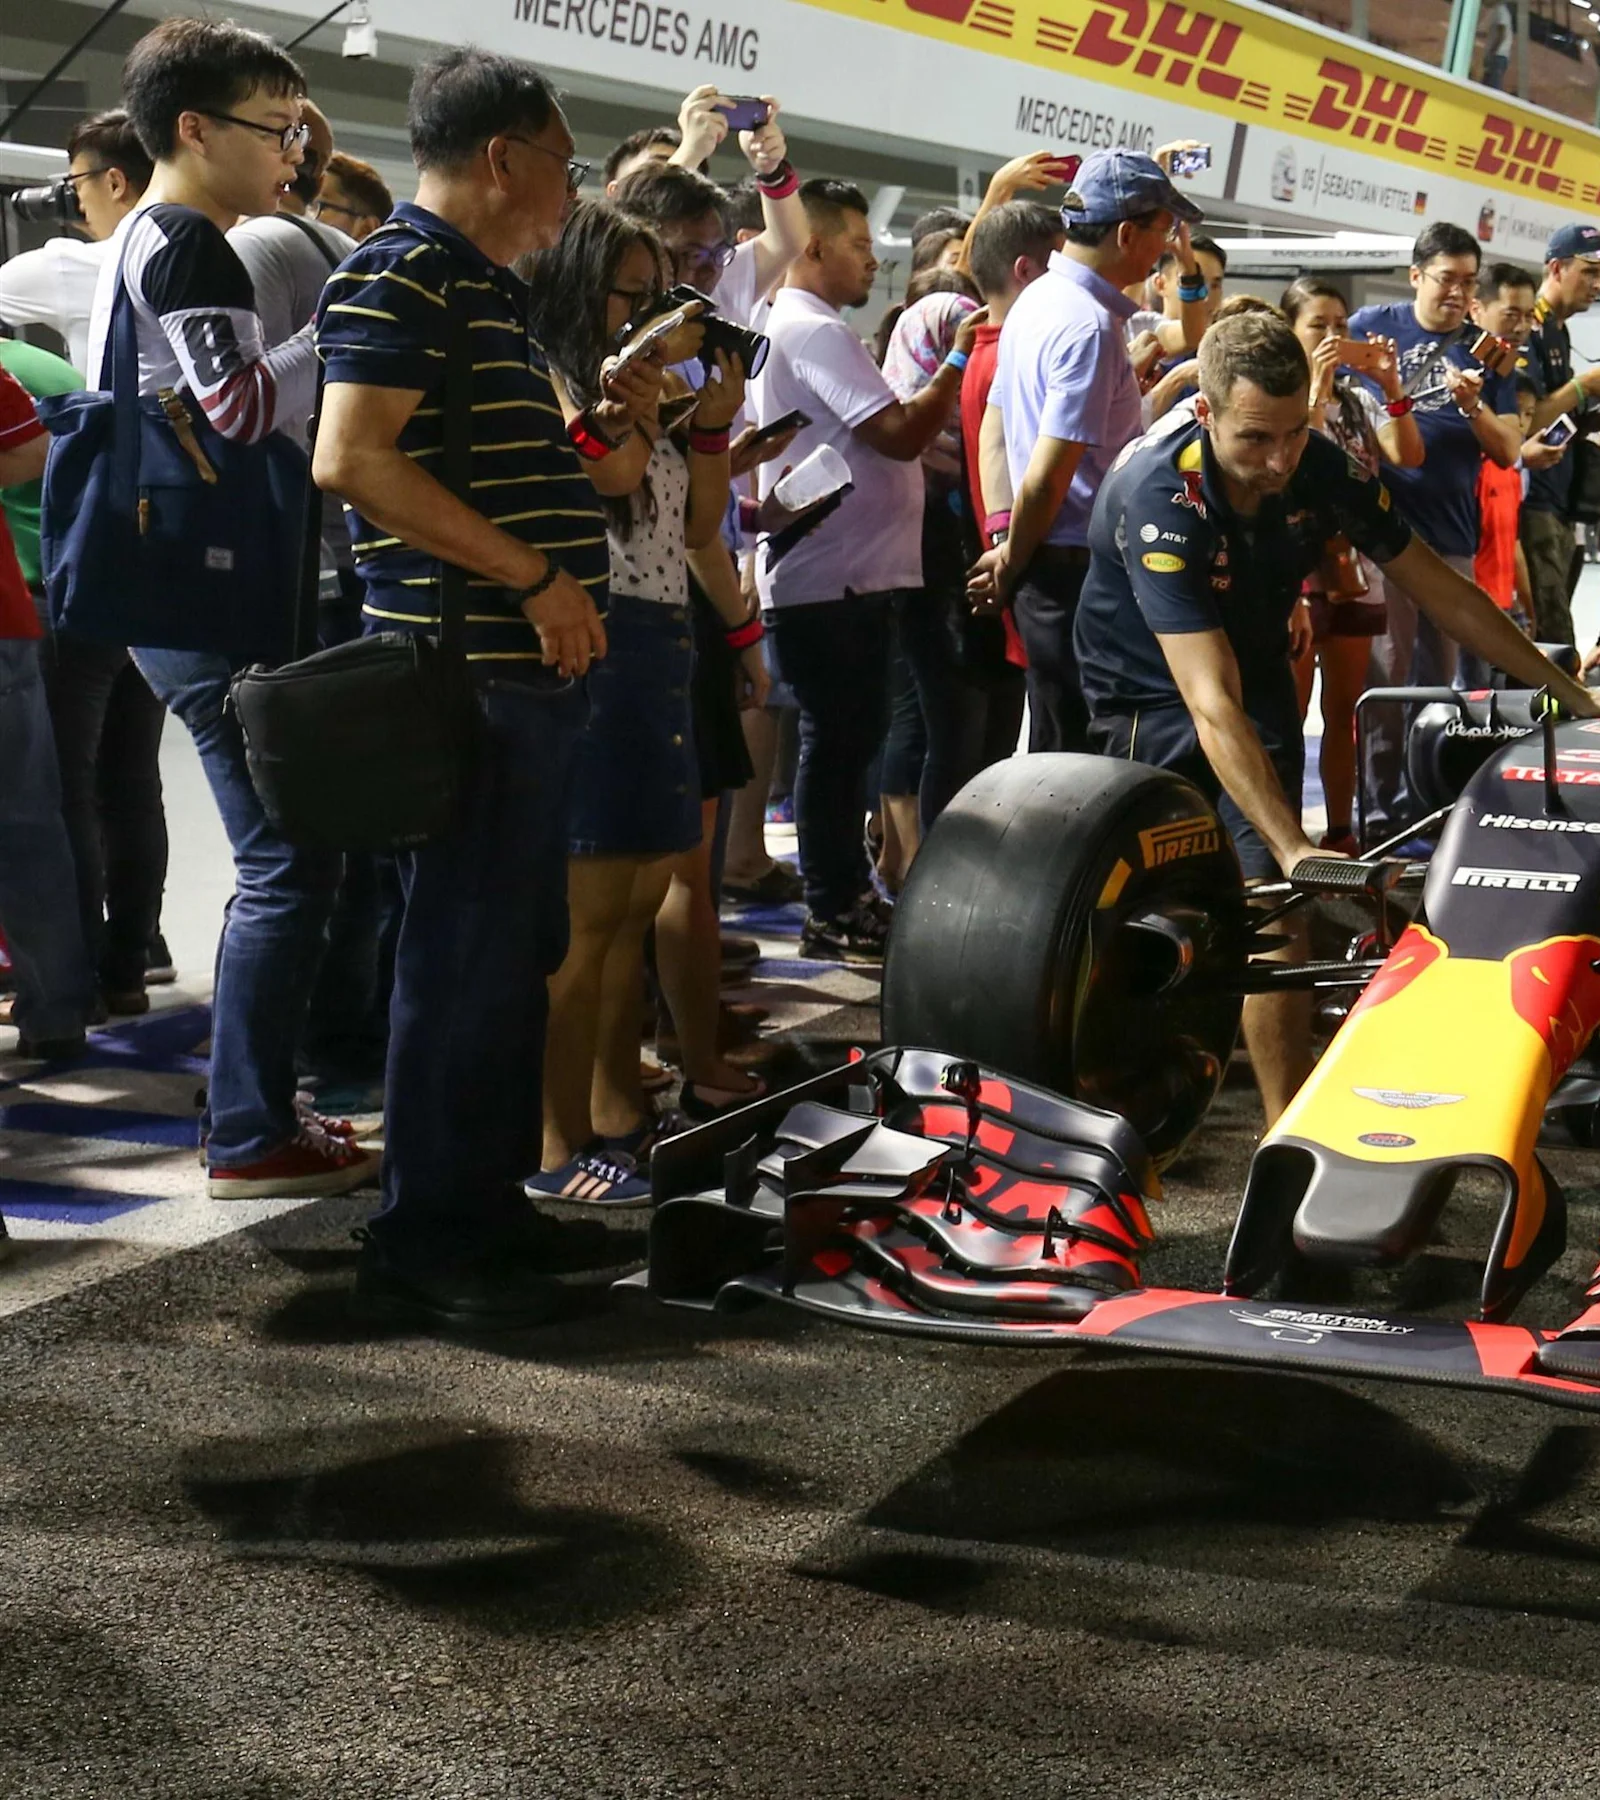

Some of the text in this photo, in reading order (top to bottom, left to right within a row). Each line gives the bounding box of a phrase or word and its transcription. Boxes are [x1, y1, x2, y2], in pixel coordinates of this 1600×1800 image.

[694, 18, 759, 71] AMG
[1073, 0, 1247, 101] DHL
[1015, 95, 1154, 155] MERCEDES AMG
[1309, 57, 1430, 156] DHL
[1474, 113, 1565, 194] DHL
[1321, 172, 1379, 204] SEBASTIAN
[1379, 186, 1413, 213] VETTEL
[1161, 531, 1188, 545] AT&T
[1138, 815, 1220, 869] PIRELLI
[1451, 866, 1582, 893] PIRELLI
[1290, 1315, 1341, 1327] ROAD
[1343, 1319, 1415, 1334] SAFETY
[1300, 1311, 1388, 1327] ACTION
